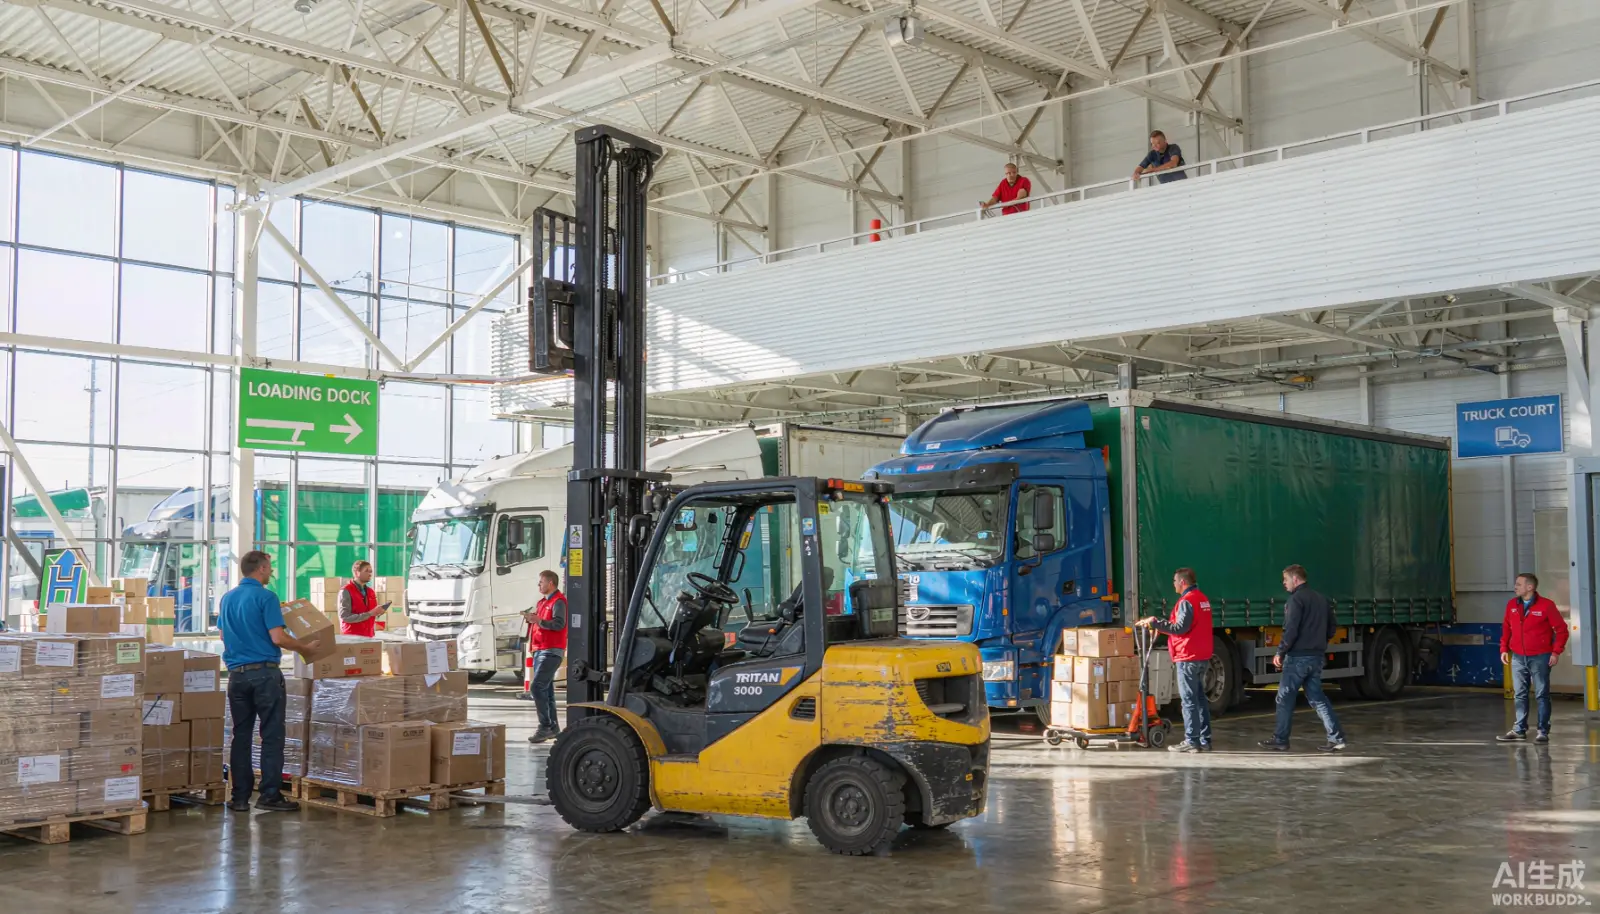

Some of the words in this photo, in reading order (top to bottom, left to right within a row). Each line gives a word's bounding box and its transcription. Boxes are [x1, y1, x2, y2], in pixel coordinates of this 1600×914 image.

[248, 381, 322, 402] LOADING
[327, 387, 372, 406] DOCK
[1461, 407, 1506, 421] TRUCK
[1509, 403, 1556, 418] COURT
[735, 672, 780, 683] TRITAN
[733, 685, 763, 696] 3000
